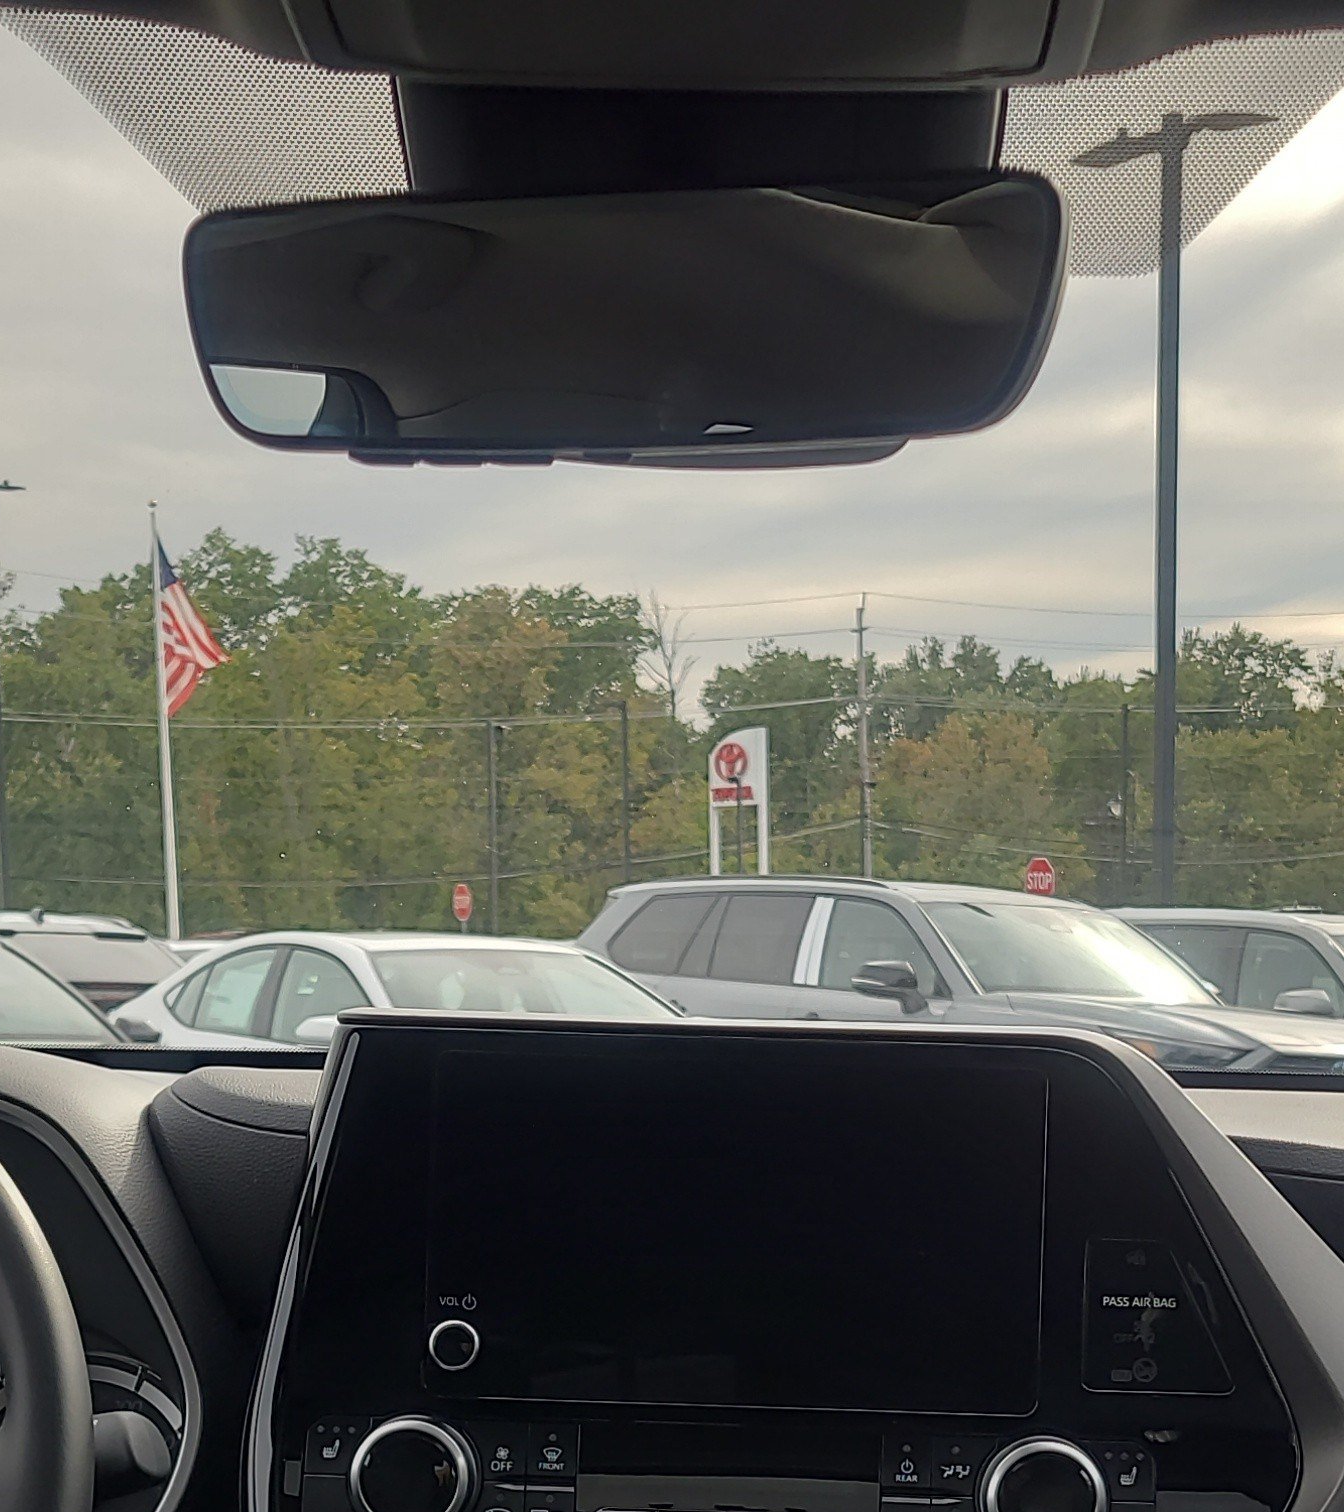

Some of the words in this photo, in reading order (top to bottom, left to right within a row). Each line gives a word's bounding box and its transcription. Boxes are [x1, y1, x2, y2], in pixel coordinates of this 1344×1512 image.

[1027, 871, 1052, 890] STOP
[439, 1296, 459, 1306] VOL
[1102, 1296, 1130, 1308] PASS
[1131, 1297, 1150, 1308] AIR
[1153, 1297, 1177, 1308] BAG
[490, 1460, 513, 1472] OFF
[537, 1461, 565, 1471] FRONT
[895, 1474, 918, 1482] REAR
